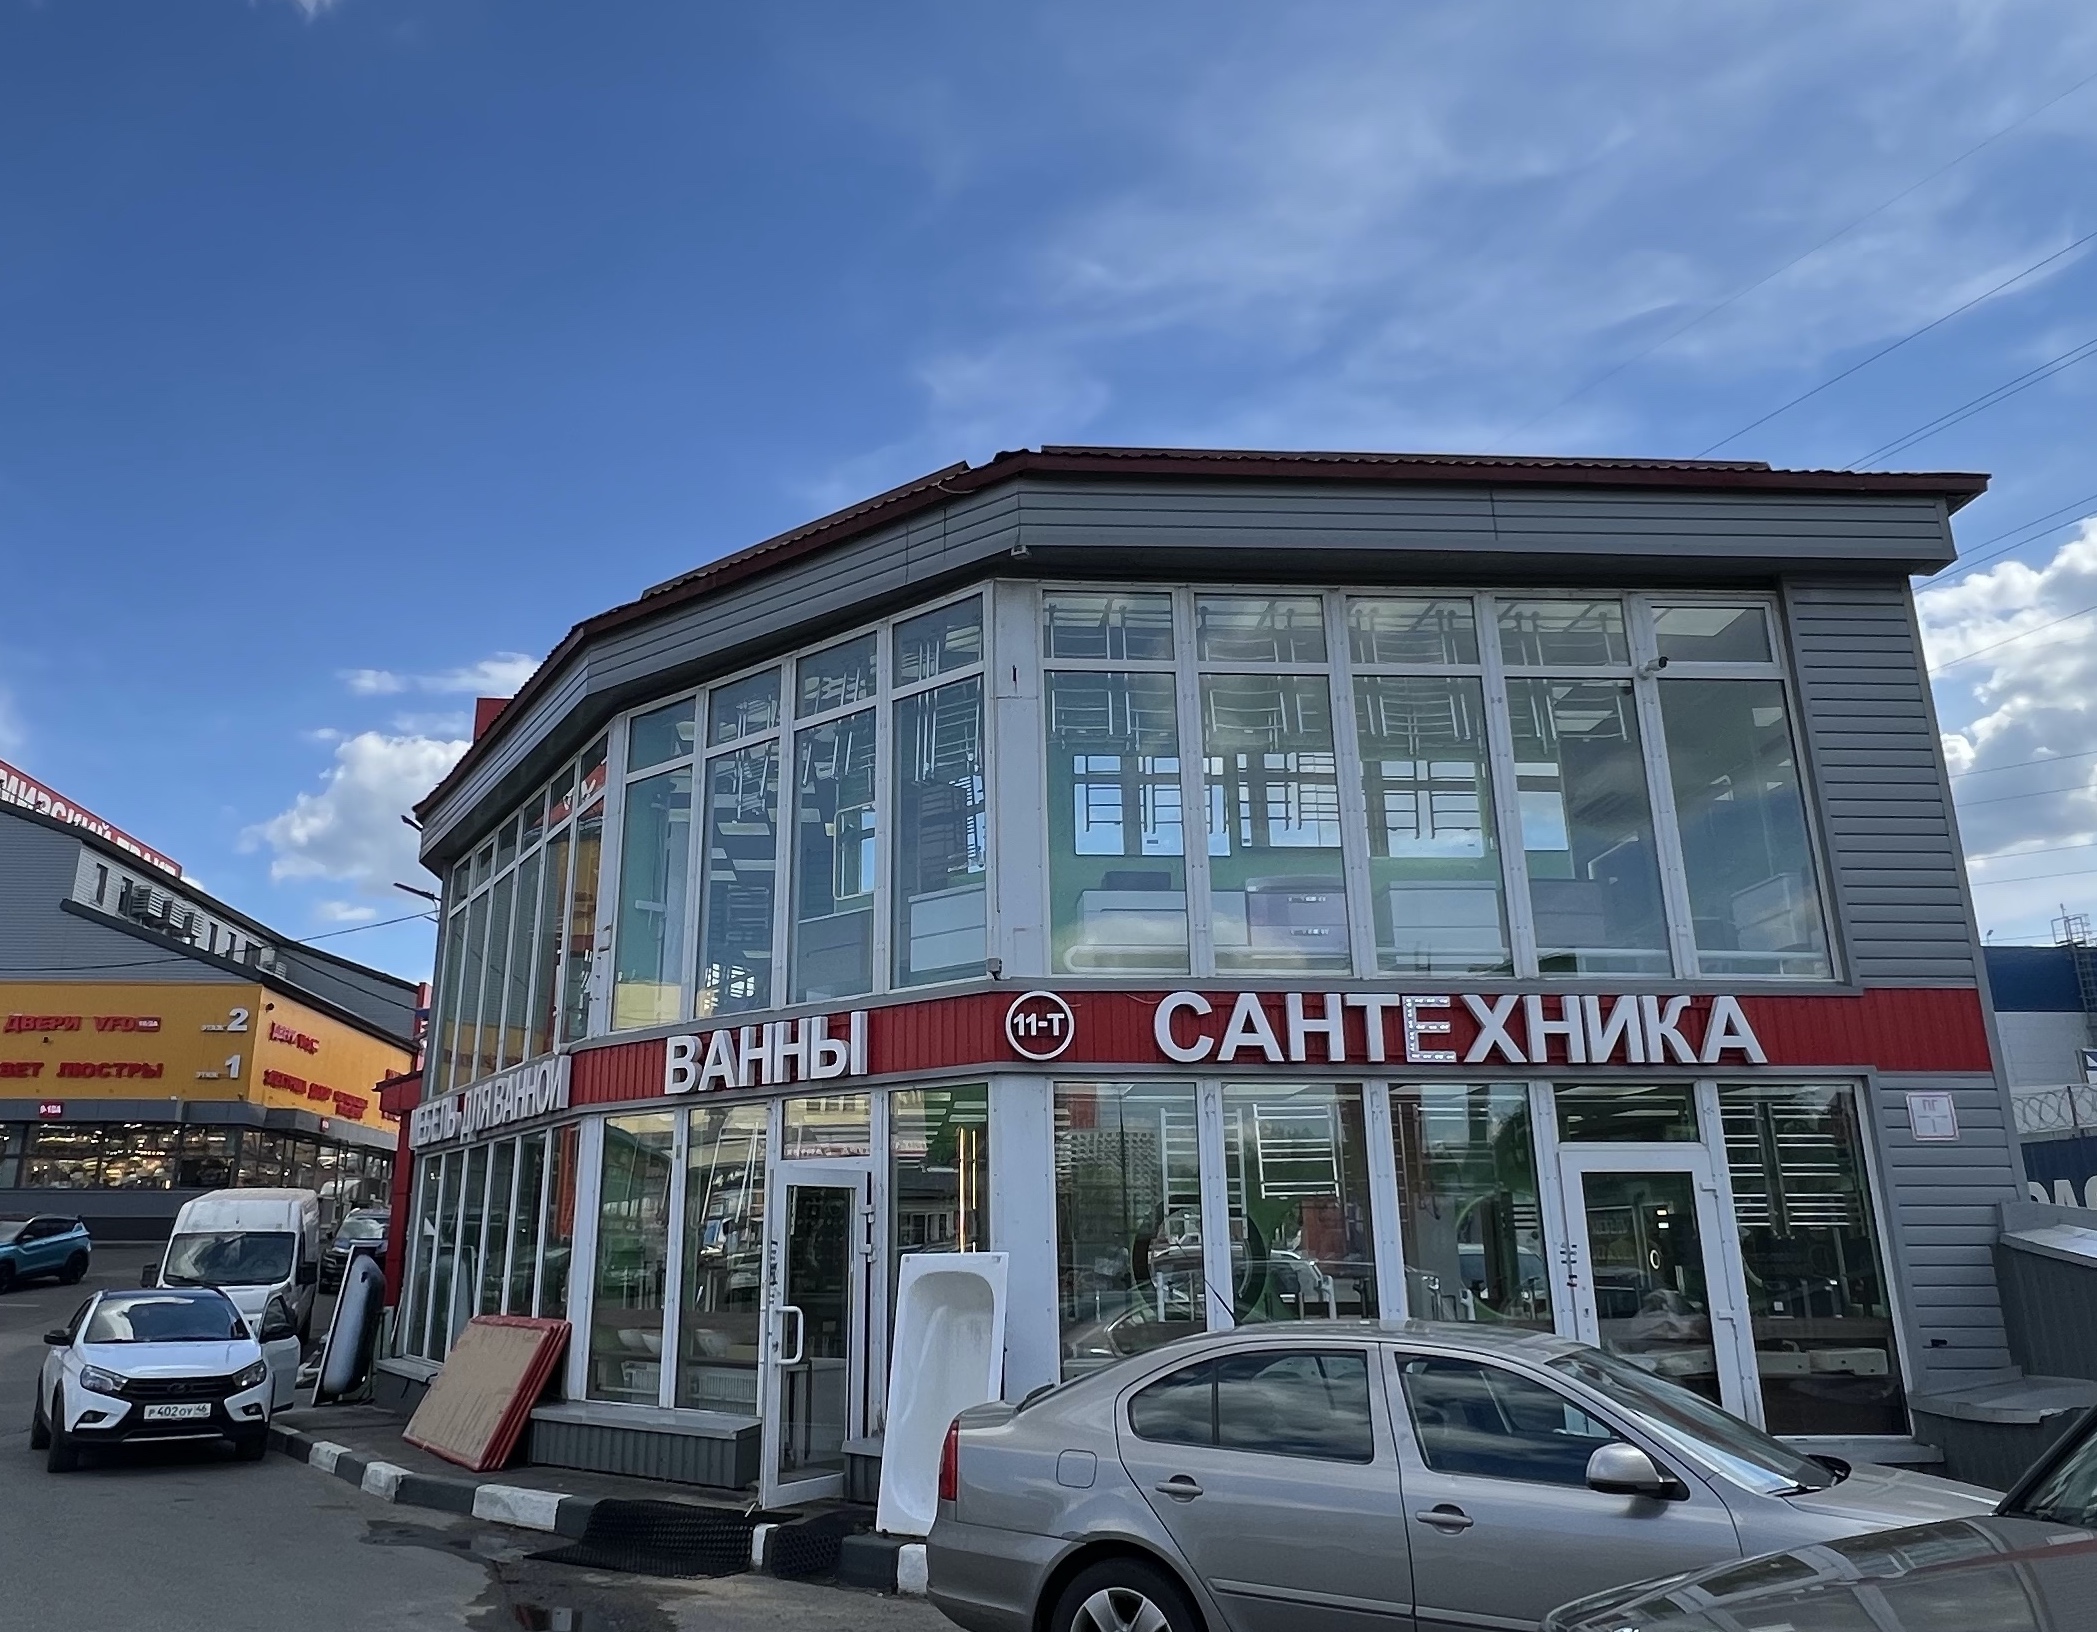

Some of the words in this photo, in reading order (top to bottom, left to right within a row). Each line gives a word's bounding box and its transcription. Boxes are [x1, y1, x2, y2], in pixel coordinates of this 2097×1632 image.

[4, 1015, 82, 1034] ДВЕРИ
[227, 1007, 249, 1032] 2
[1153, 991, 1768, 1064] САНТЕХНИКА
[664, 1010, 869, 1096] ВАННЫ
[56, 1062, 164, 1079] ЛЮСТРЫ
[224, 1054, 241, 1079] 1
[459, 1081, 493, 1145] ДЛЯ
